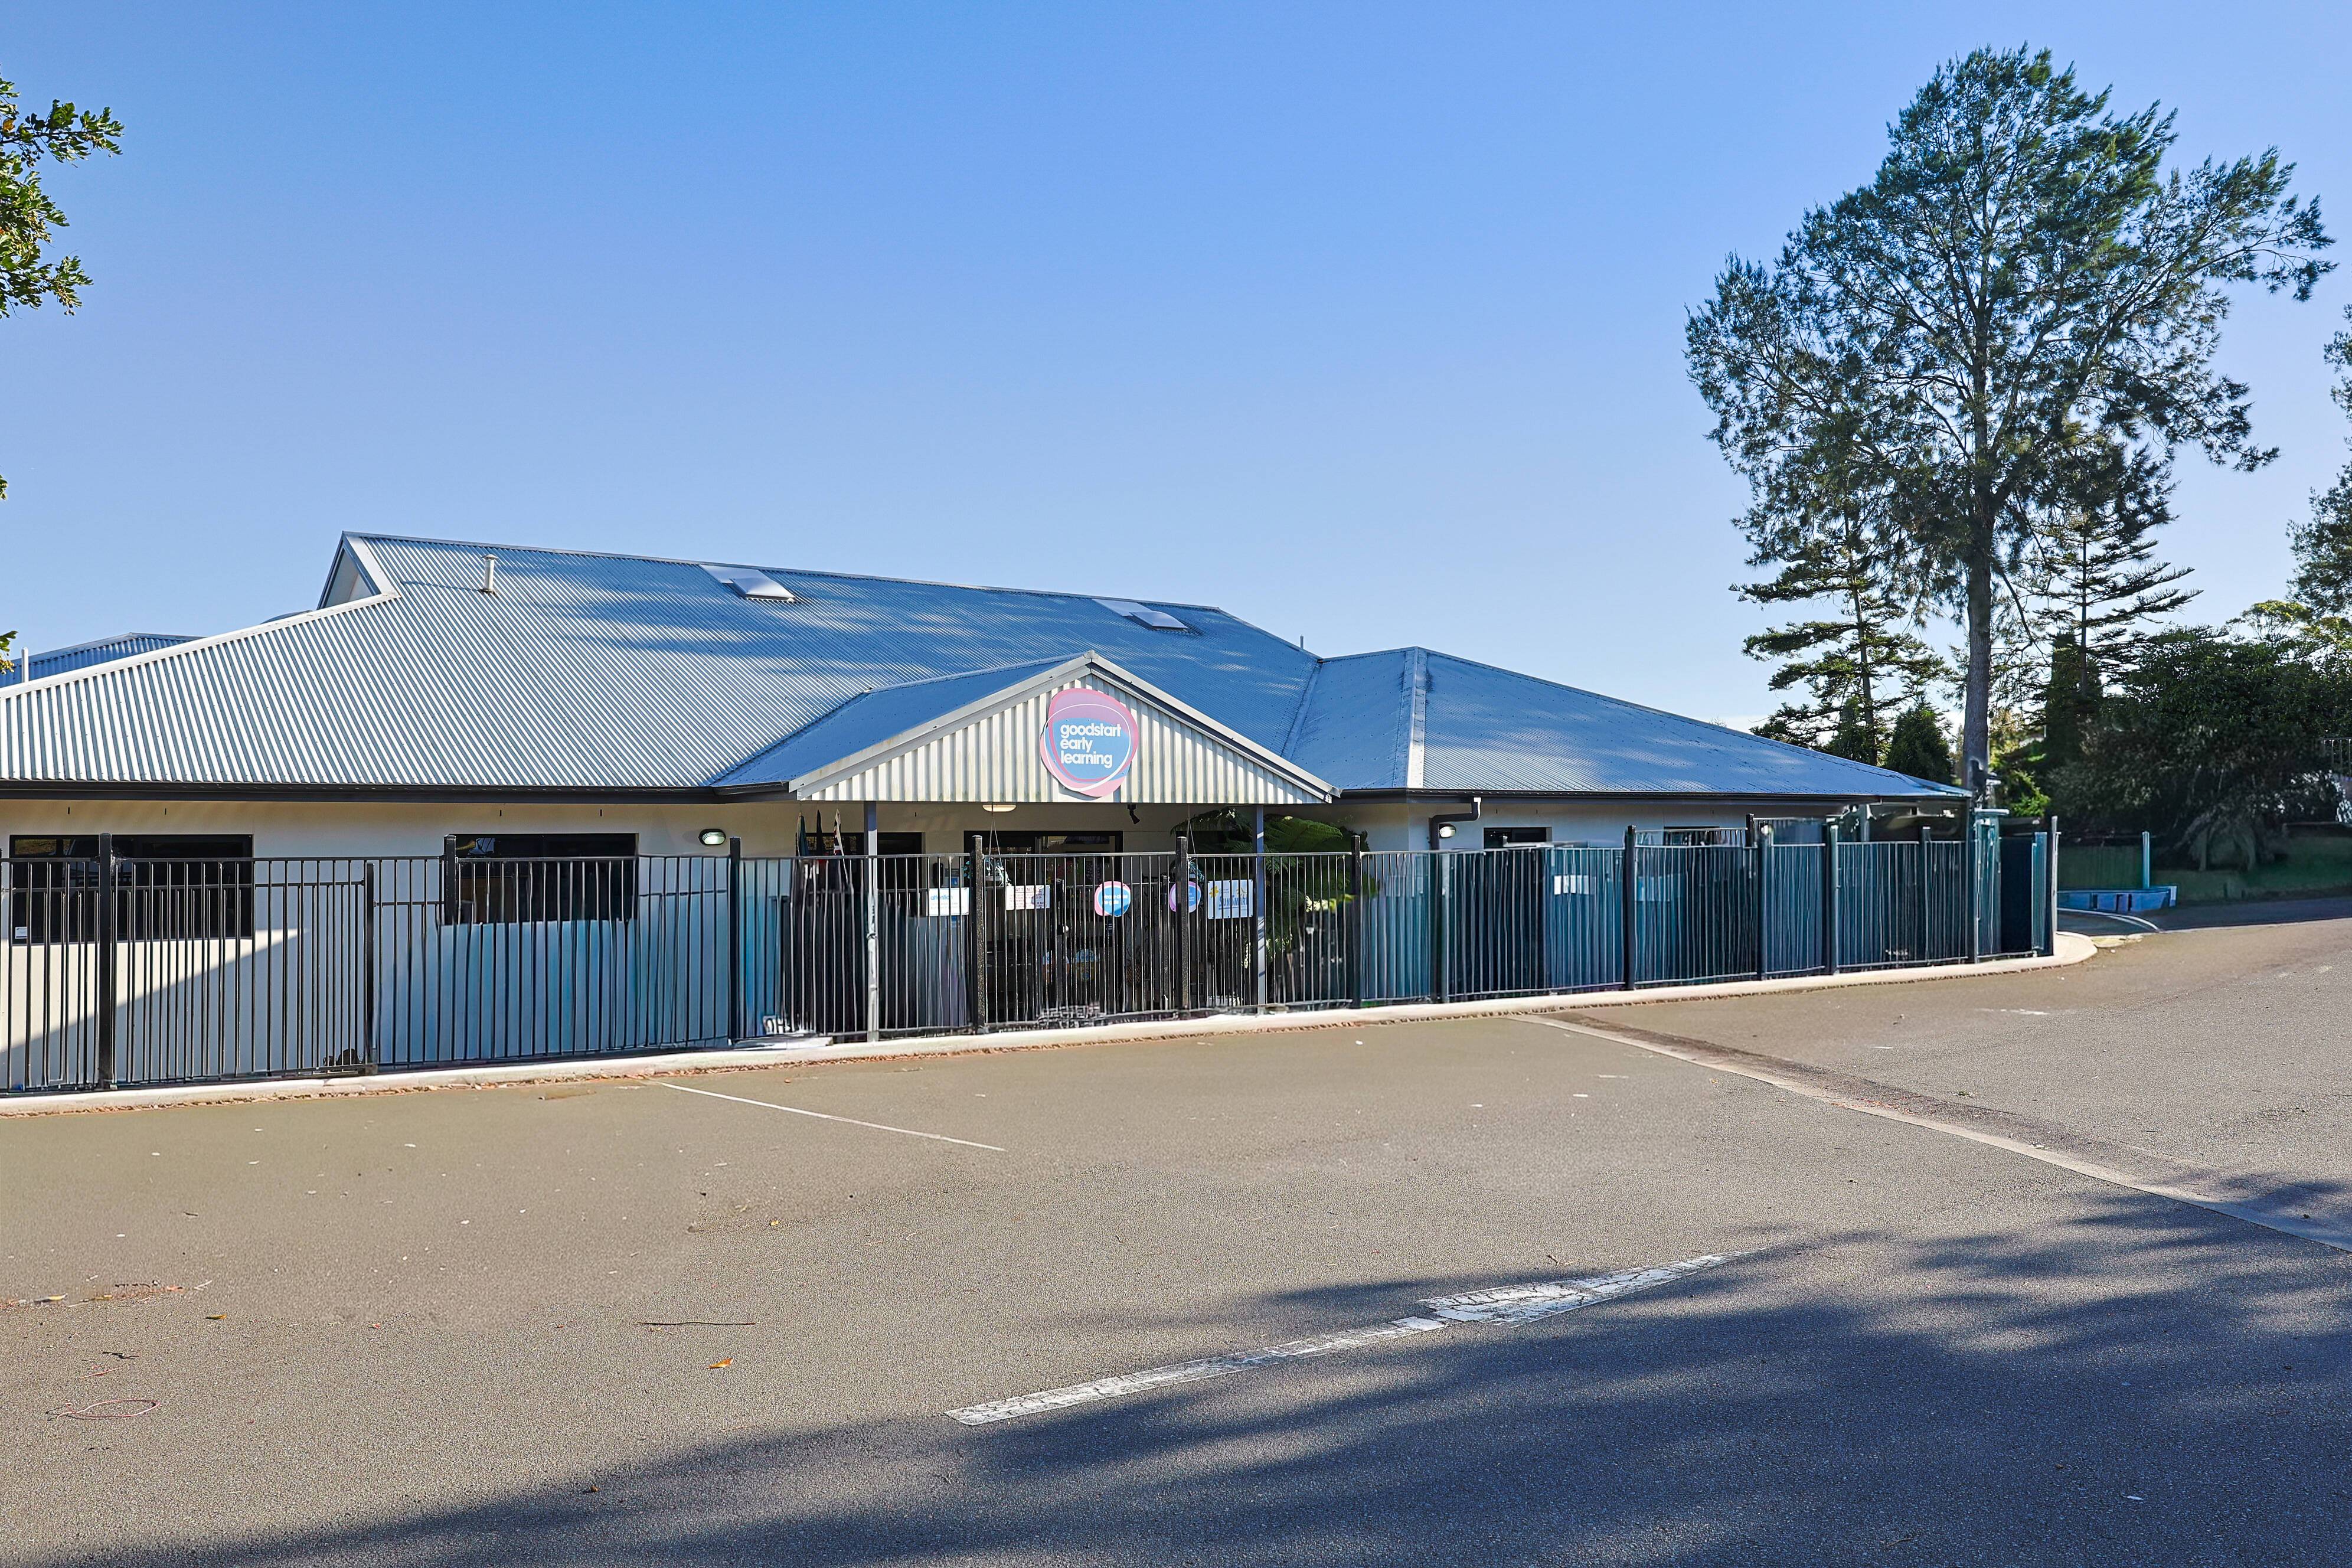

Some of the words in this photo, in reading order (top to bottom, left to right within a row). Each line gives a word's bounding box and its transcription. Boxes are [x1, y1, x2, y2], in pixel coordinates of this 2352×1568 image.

[1060, 723, 1122, 739] goodstart
[1060, 736, 1093, 753] early
[1060, 750, 1113, 769] learning
